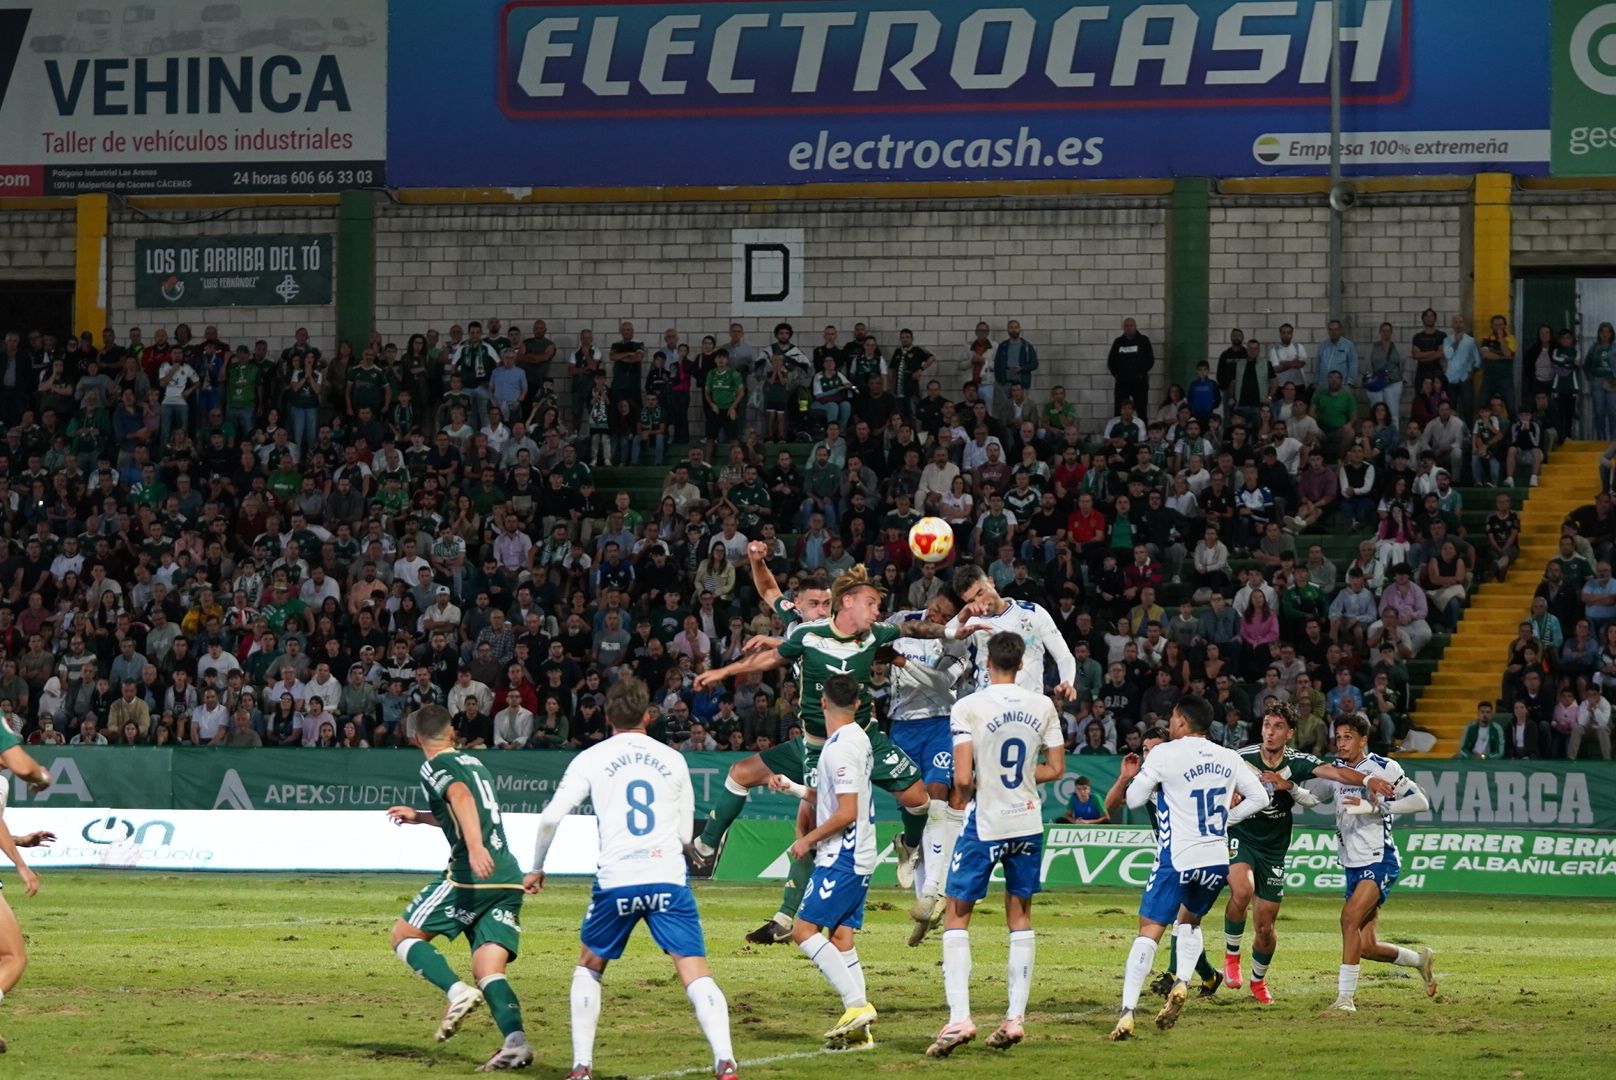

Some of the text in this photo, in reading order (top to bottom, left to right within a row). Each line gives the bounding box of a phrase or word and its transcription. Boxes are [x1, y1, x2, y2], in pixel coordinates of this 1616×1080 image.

[517, 1, 1392, 97] ELECTROCASH
[44, 55, 352, 116] VEHINCA
[42, 127, 353, 153] Taller de vehículos industriales
[788, 126, 1104, 170] electrocash.es
[1288, 138, 1508, 161] Empesa 100% extremeña
[233, 170, 373, 185] 24 horas 606 66 33 03
[146, 240, 321, 274] LOS DE ARRIBA DEL TÓ
[744, 244, 789, 302] D
[986, 710, 1042, 733] DE MIGUEL
[604, 753, 632, 778] JAVI
[1000, 737, 1027, 789] 9
[1183, 762, 1232, 783] FABRICIO
[496, 775, 548, 791] Marca
[626, 779, 656, 836] 8
[1415, 771, 1594, 824] MARCA
[1190, 786, 1229, 837] 15
[1406, 833, 1525, 854] FERRER
[1411, 856, 1446, 870] DE
[616, 893, 673, 917] EAVE
